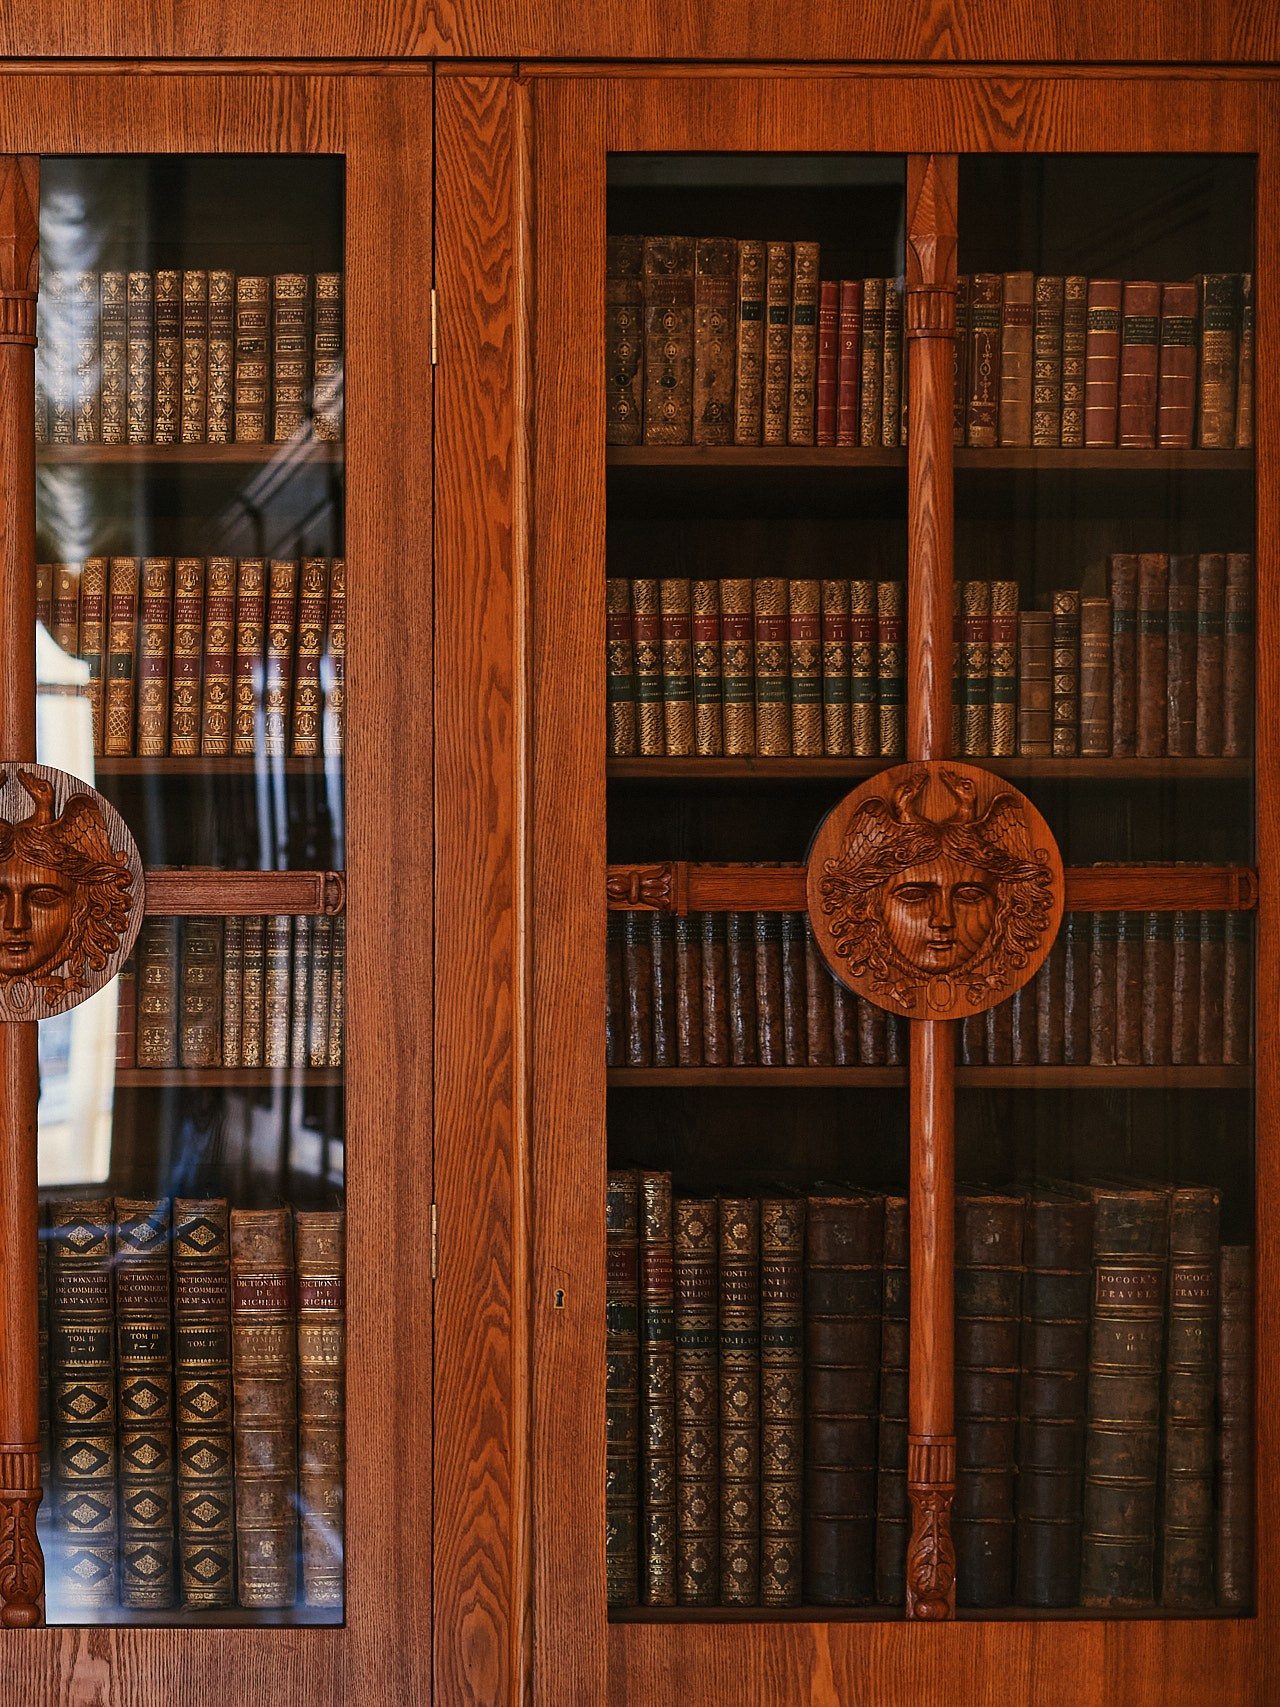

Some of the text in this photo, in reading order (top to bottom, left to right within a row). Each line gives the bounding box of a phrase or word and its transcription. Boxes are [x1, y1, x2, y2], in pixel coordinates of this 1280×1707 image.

[845, 340, 853, 350] 2
[736, 630, 742, 638] 8
[800, 630, 812, 638] 10
[833, 630, 844, 639] 11
[859, 630, 870, 638] 12
[117, 663, 124, 671] 2
[675, 1268, 712, 1276] MONTFAU
[55, 1276, 109, 1284] DICTIONNAIRE
[1100, 1274, 1158, 1285] POCOCK'S
[1174, 1272, 1213, 1282] POCOCK'
[236, 1279, 287, 1288] DICTIONAIRE
[721, 1281, 753, 1289] ANTIQU
[1100, 1289, 1158, 1299] TRAVELS
[1174, 1288, 1212, 1297] TRAVEL
[303, 1298, 344, 1306] RICHEL
[1185, 1328, 1203, 1337] VO
